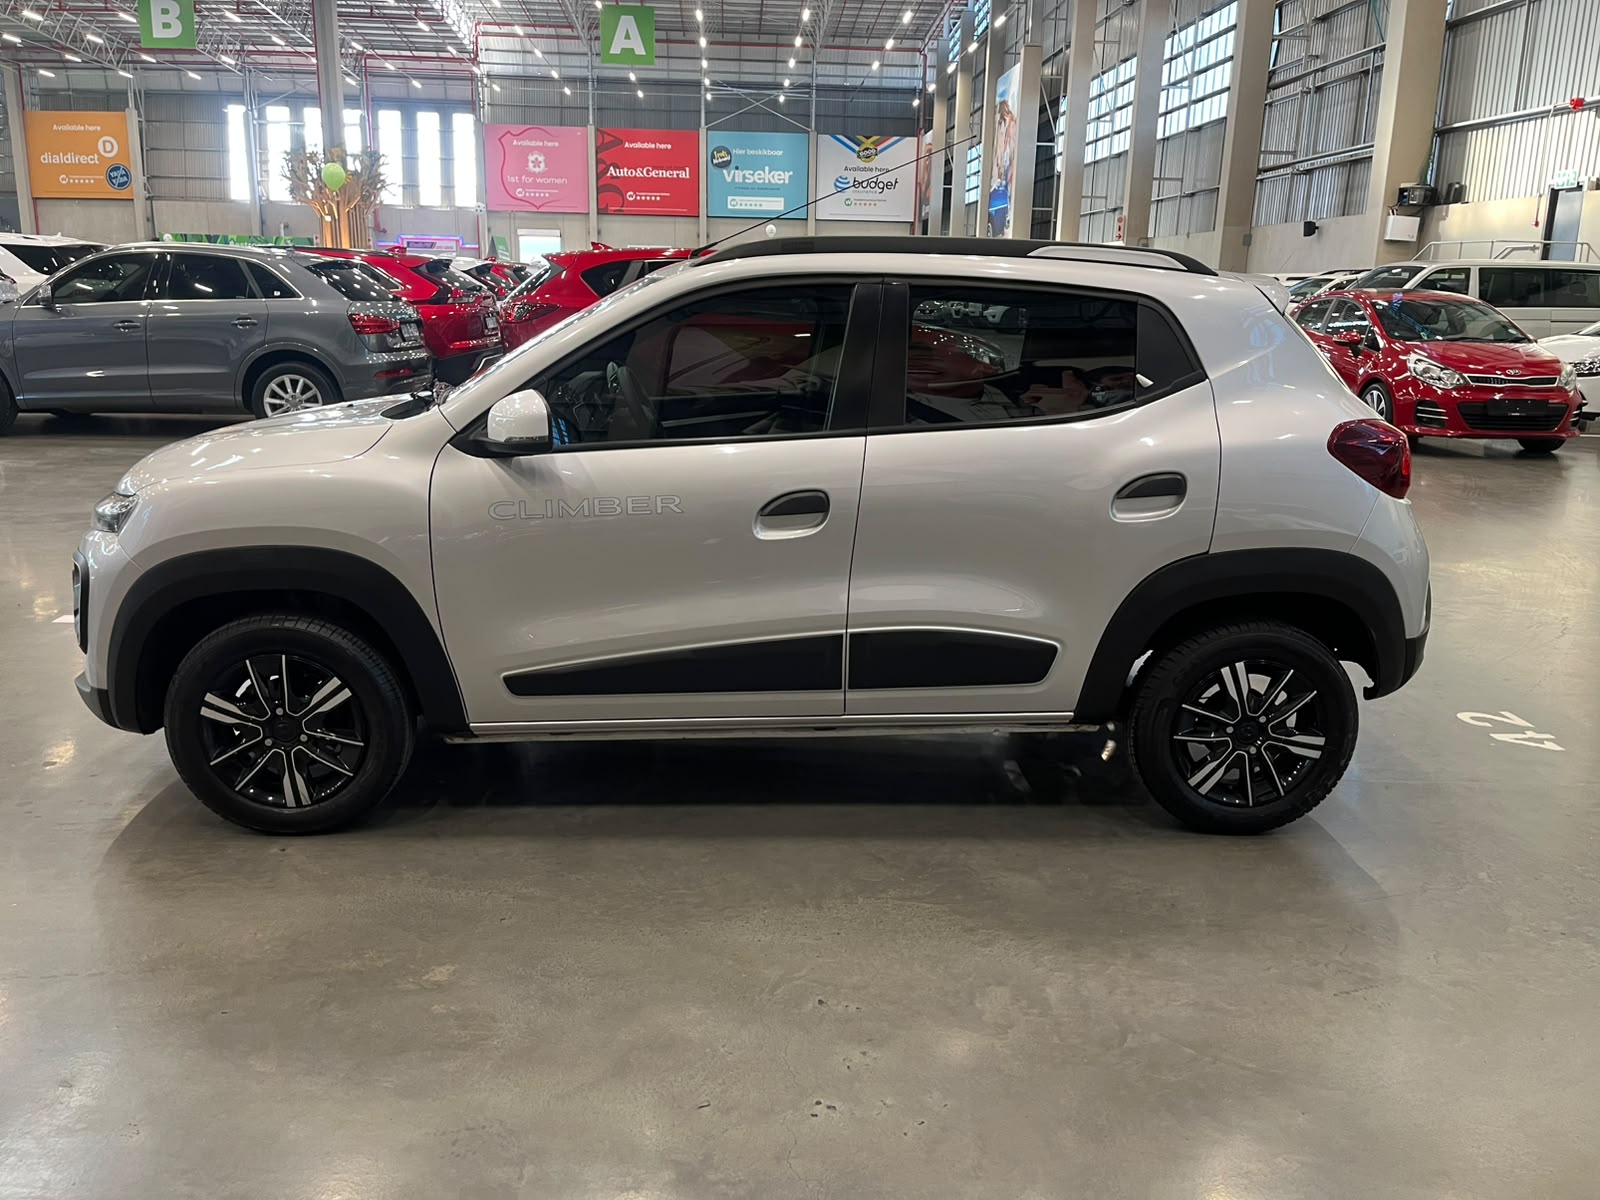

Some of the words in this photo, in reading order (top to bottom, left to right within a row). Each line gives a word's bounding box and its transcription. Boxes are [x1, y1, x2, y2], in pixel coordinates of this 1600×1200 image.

[151, 0, 182, 38] B
[609, 15, 646, 55] A
[512, 139, 543, 147] Available
[40, 152, 99, 164] dialdirect
[507, 175, 519, 183] 1st
[522, 175, 533, 183] for
[607, 166, 690, 179] Auto&General
[723, 165, 793, 184] virseker
[853, 177, 898, 194] budget
[488, 495, 684, 521] CLIMBER
